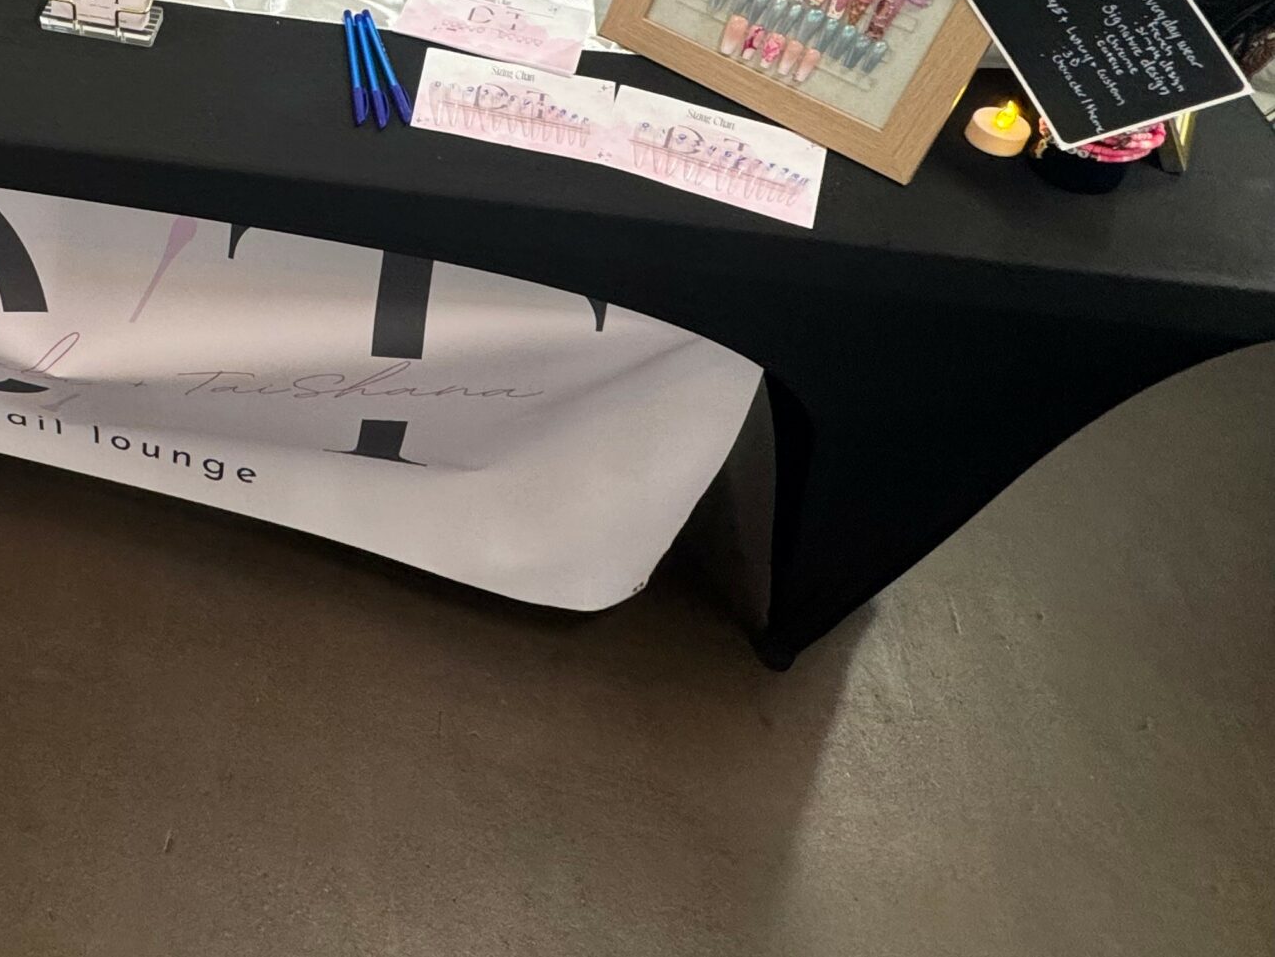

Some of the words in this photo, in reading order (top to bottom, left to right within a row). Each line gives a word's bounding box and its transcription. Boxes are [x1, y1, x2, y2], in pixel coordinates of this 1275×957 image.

[1177, 40, 1203, 68] wear
[490, 65, 514, 78] Sizing
[1140, 58, 1170, 96] design
[685, 107, 712, 124] Sizing
[93, 424, 258, 484] lounge
